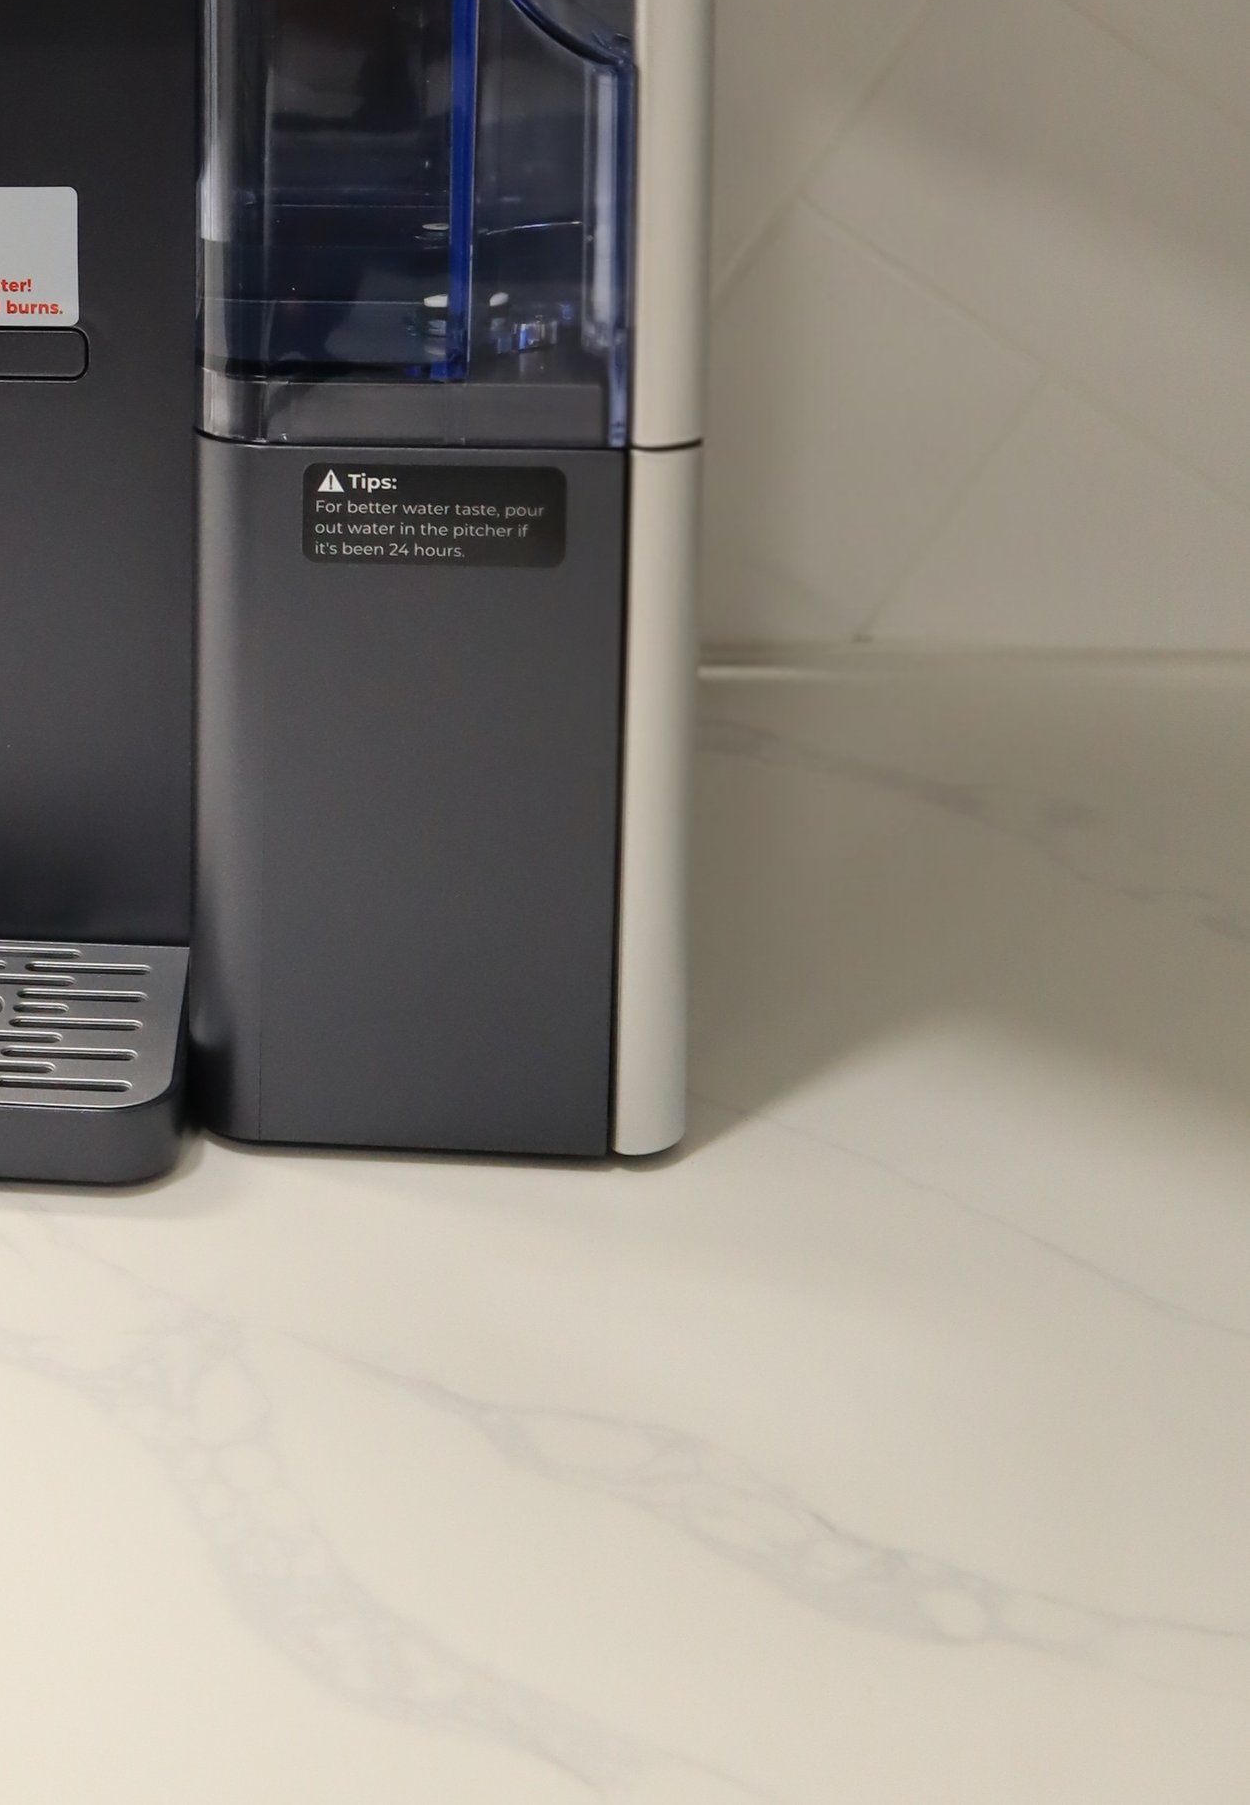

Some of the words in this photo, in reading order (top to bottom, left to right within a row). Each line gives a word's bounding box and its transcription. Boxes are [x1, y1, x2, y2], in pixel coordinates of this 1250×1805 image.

[6, 300, 64, 315] burns.
[347, 473, 398, 493] Tips:
[315, 500, 342, 514] For
[347, 500, 398, 515] better
[402, 502, 450, 516] water
[454, 503, 500, 519] taste,
[505, 506, 545, 520] pour
[314, 523, 343, 535] out
[347, 523, 395, 535] water
[400, 522, 415, 536] in
[420, 522, 448, 536] the
[453, 523, 512, 540] pitcher
[518, 523, 529, 537] if
[314, 541, 338, 555] it's
[342, 542, 385, 556] been
[388, 543, 409, 556] 24
[414, 542, 466, 558] hours.
